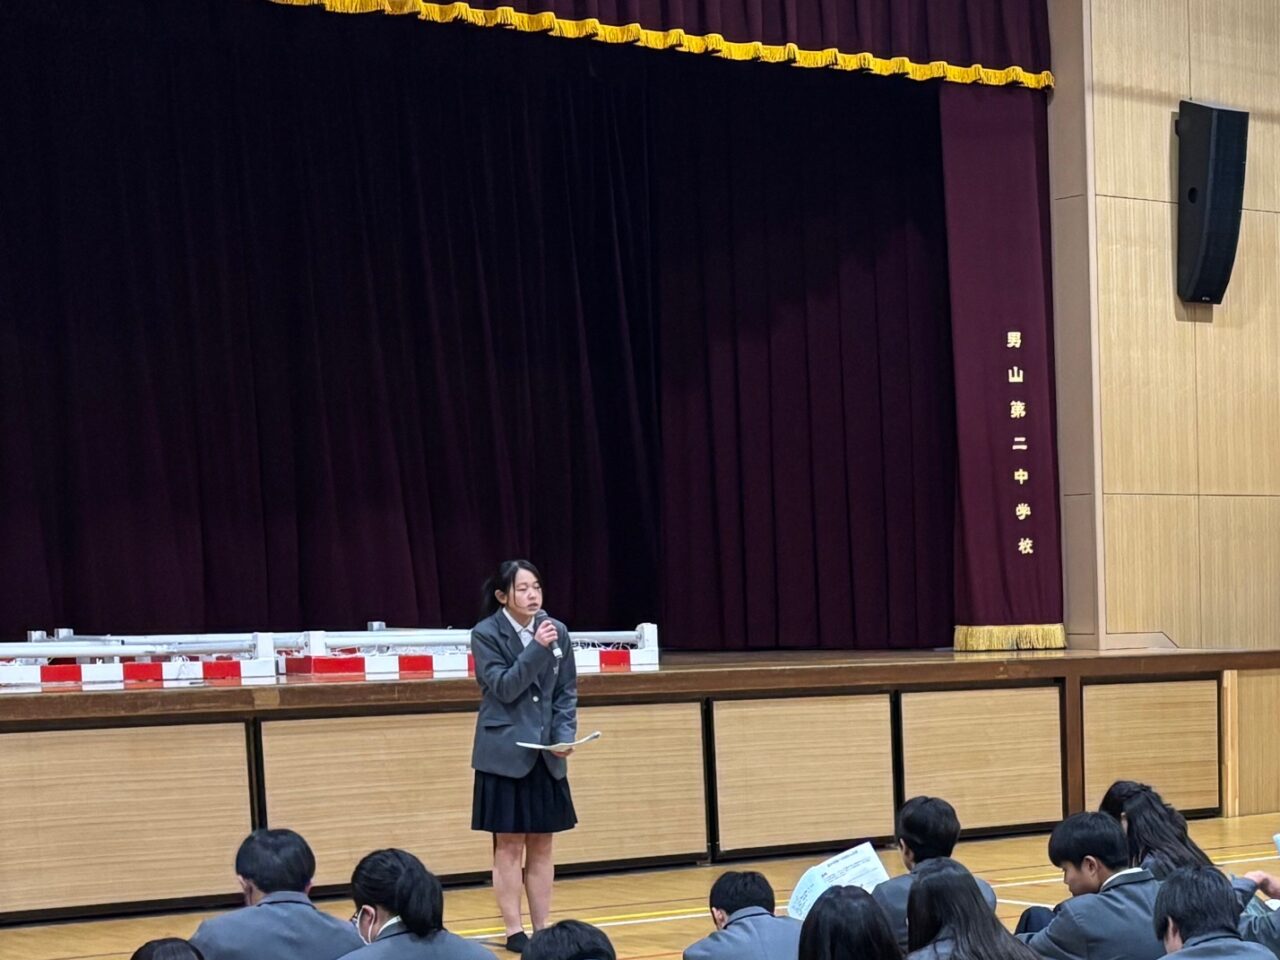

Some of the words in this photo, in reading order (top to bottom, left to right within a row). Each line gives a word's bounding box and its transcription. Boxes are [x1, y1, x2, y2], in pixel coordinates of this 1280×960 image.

[1006, 331, 1034, 554] 男山第二中学校
